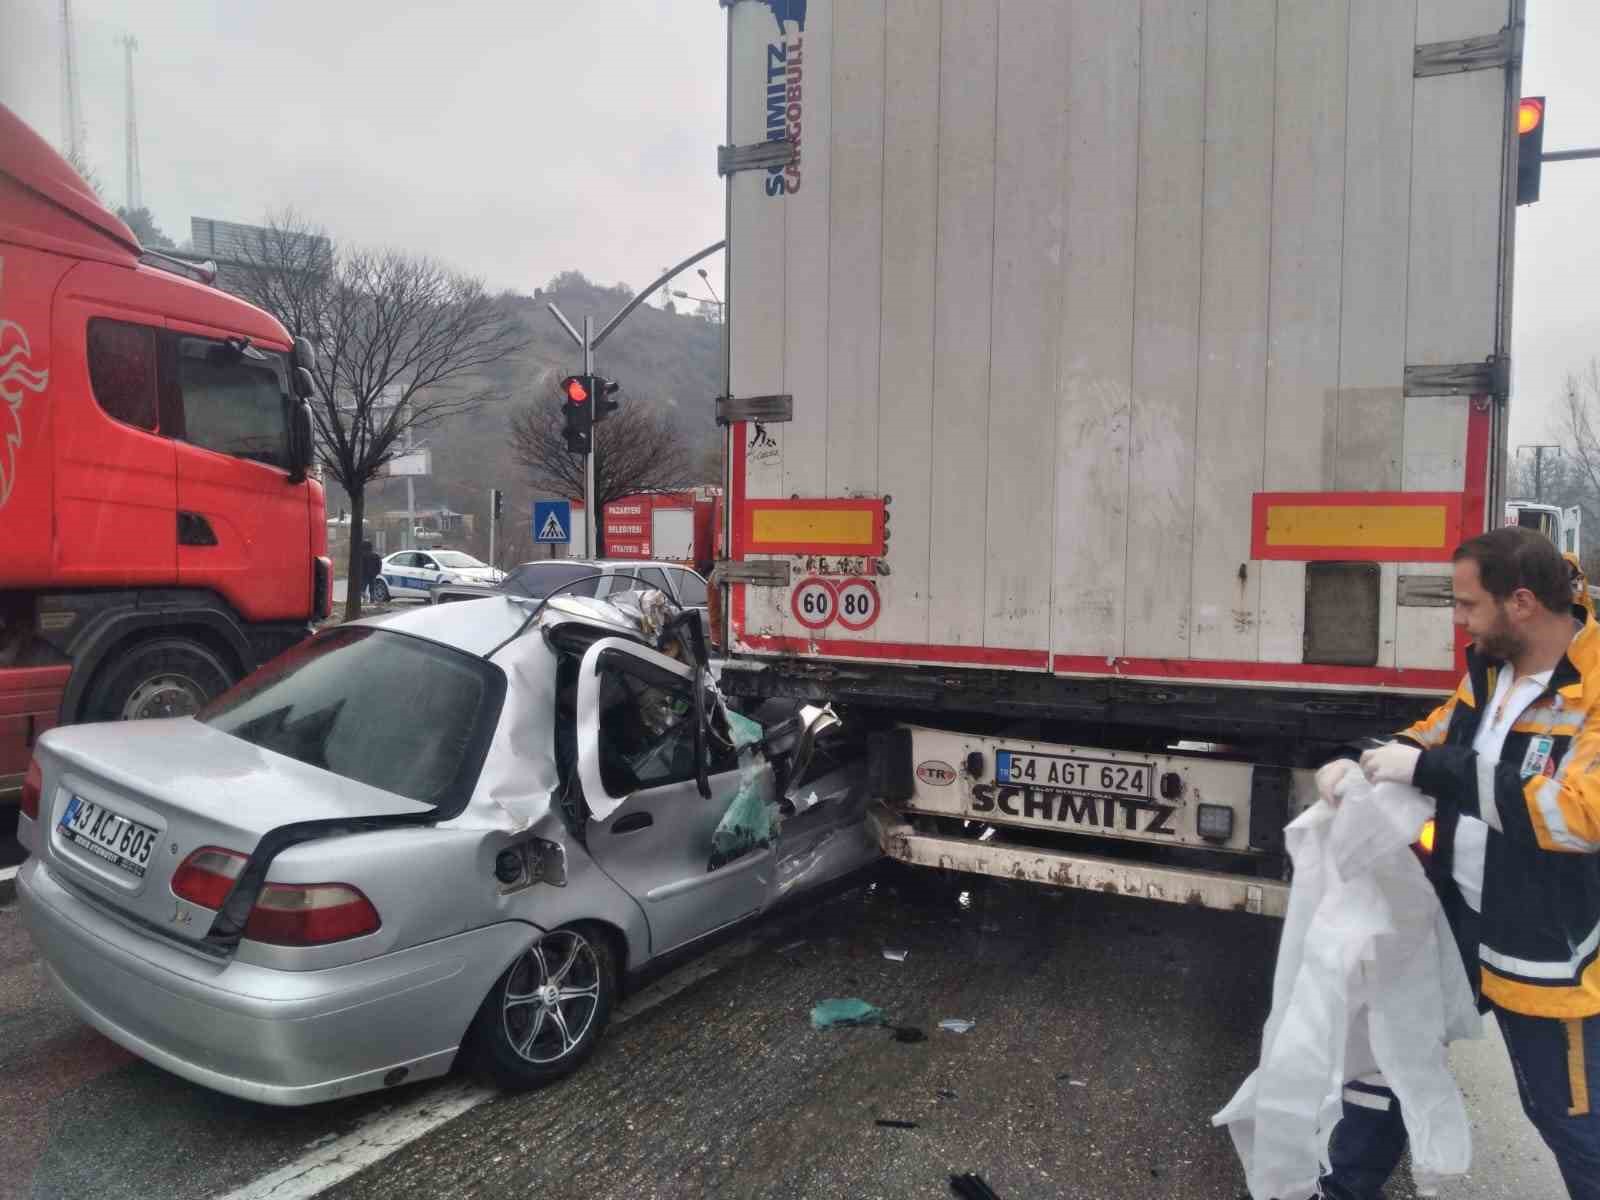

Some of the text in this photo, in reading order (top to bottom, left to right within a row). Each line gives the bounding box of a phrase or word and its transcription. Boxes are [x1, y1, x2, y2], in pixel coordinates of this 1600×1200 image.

[804, 593, 868, 614] 60 80
[927, 768, 945, 779] TR
[1011, 758, 1036, 781] 54
[1048, 761, 1089, 786] AGT
[1101, 766, 1143, 792] 624
[972, 784, 1176, 835] SCHMITZ
[73, 800, 95, 830] 43
[89, 809, 123, 846] ACJ
[120, 824, 156, 863] 605
